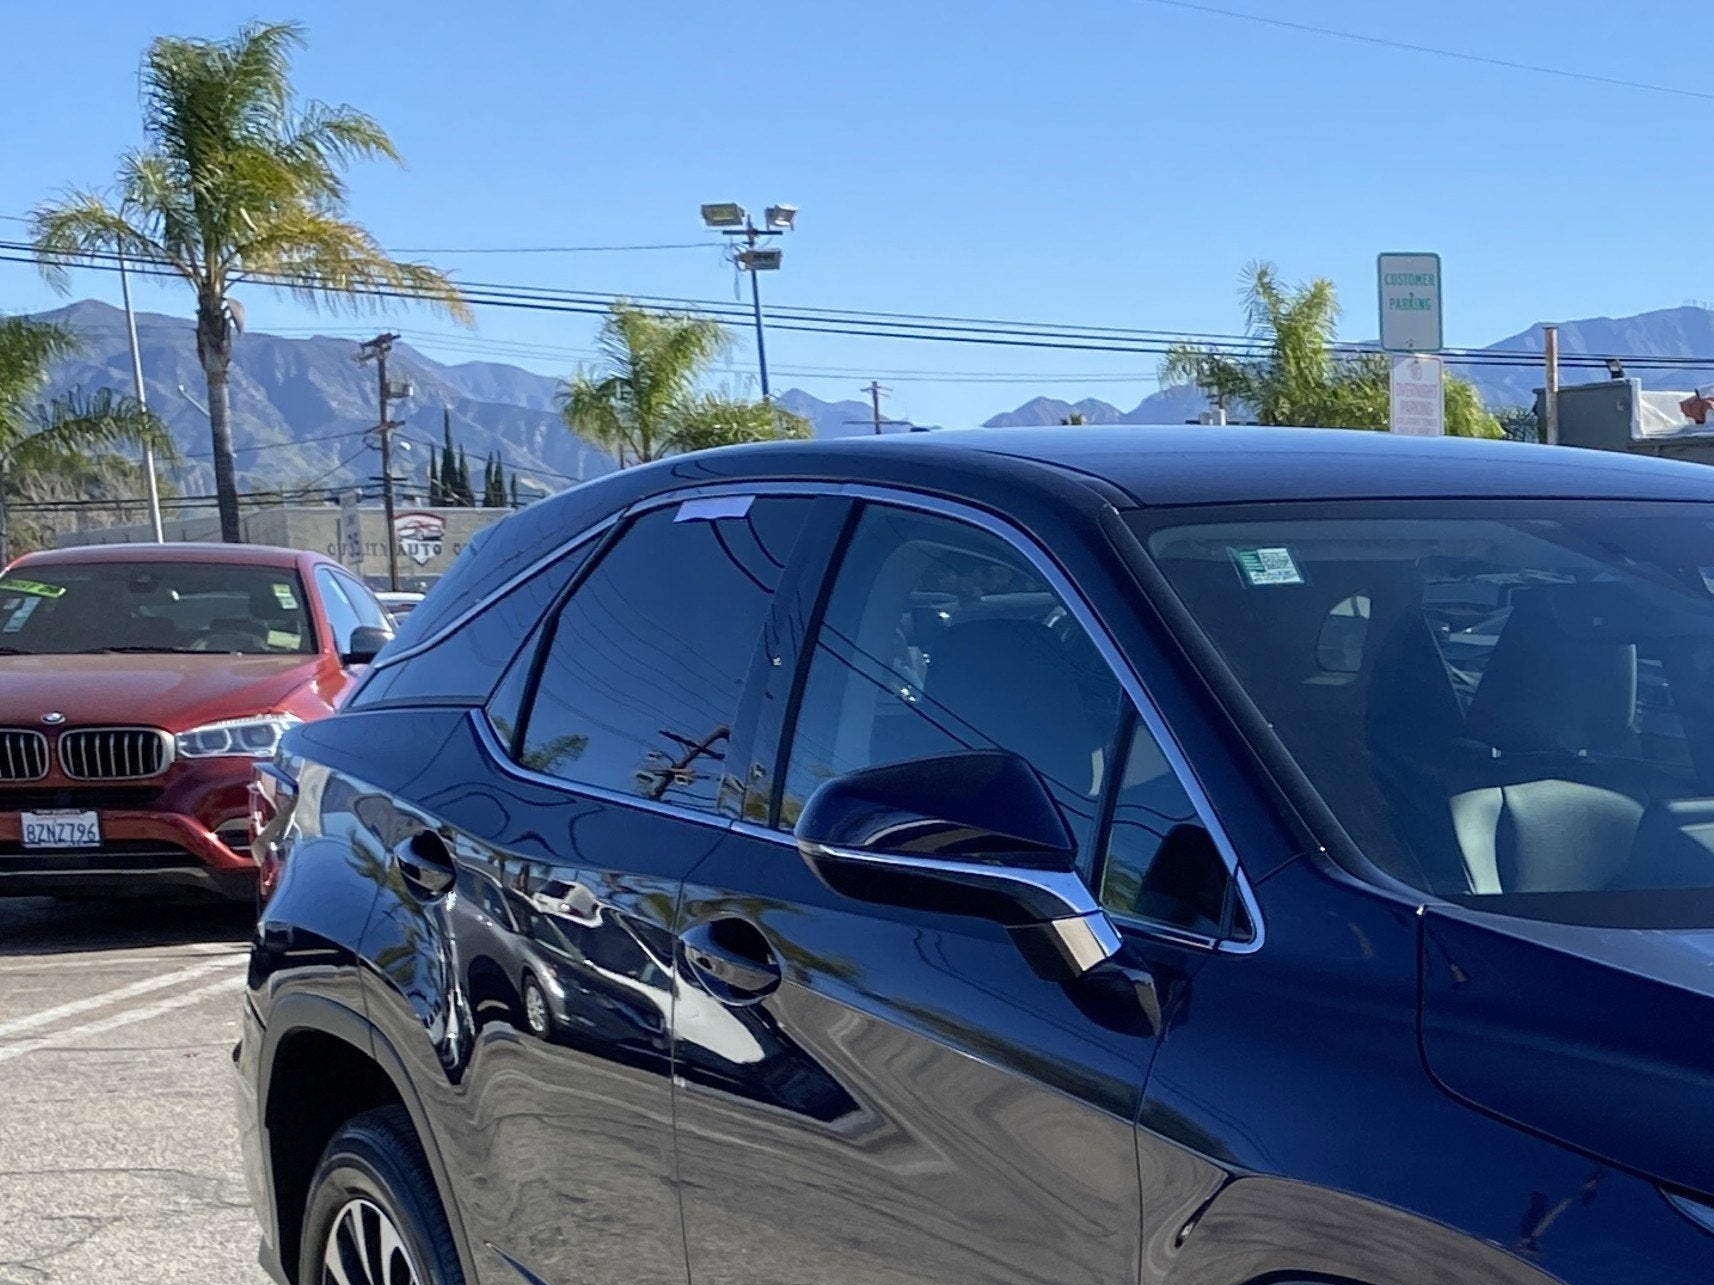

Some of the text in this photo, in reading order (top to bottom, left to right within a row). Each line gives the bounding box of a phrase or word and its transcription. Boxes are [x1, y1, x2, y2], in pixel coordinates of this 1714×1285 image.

[1384, 272, 1436, 286] CUSTOMER
[1389, 297, 1432, 311] PARKING
[26, 822, 97, 843] 8ZNZ796
